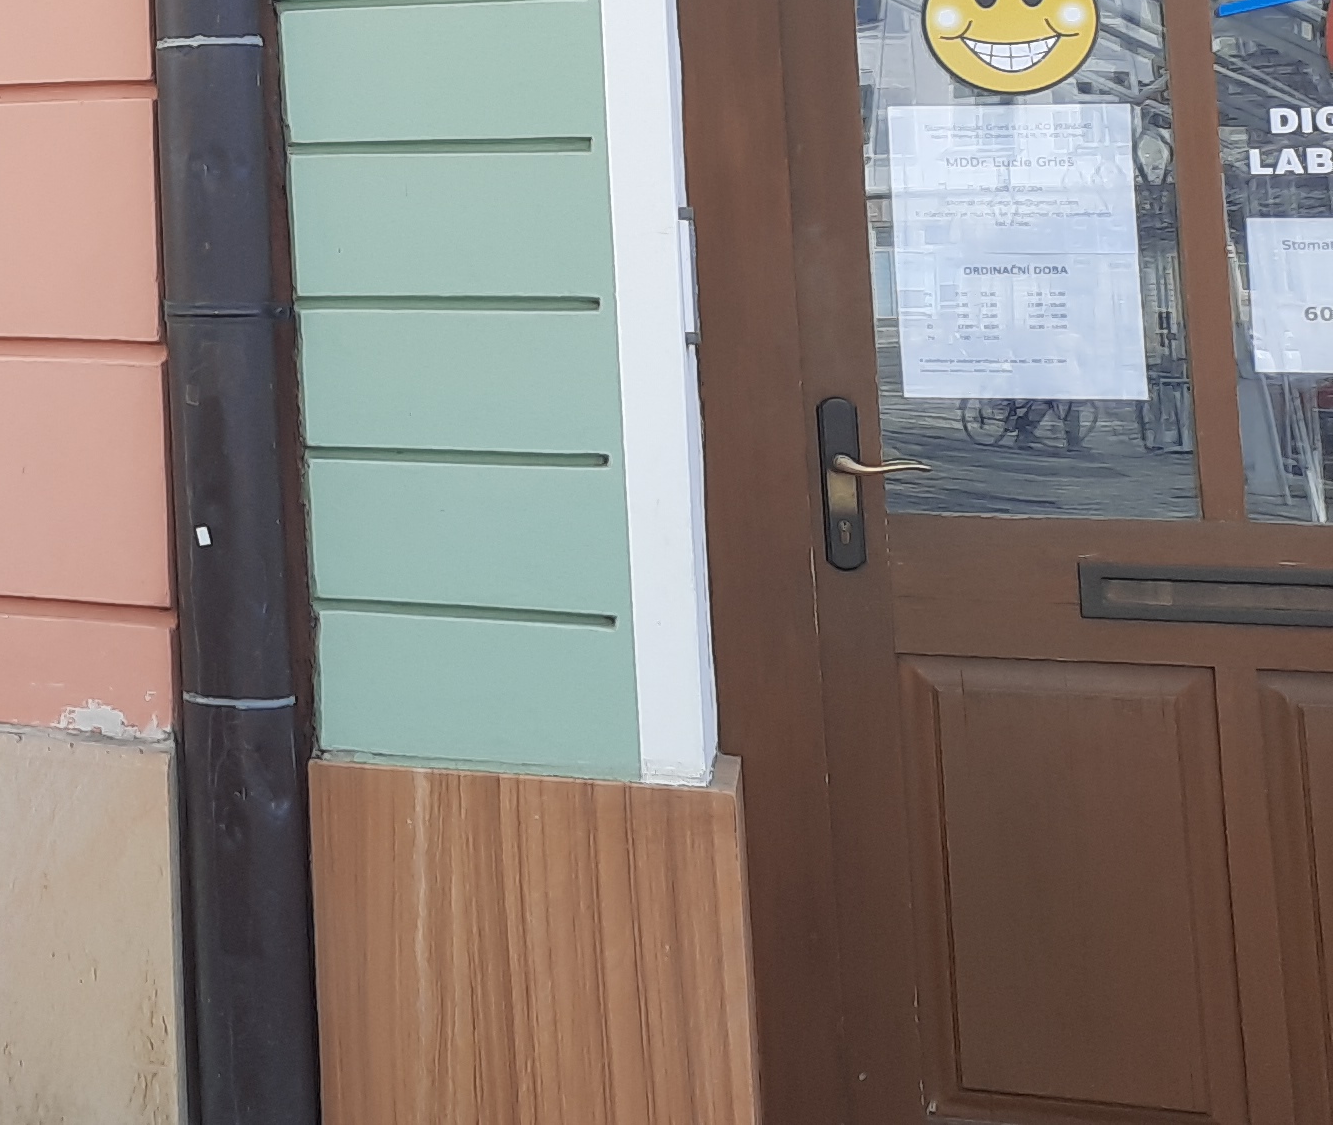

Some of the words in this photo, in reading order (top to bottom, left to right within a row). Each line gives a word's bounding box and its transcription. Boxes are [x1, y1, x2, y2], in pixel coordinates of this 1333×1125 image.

[1248, 147, 1333, 175] LAB
[963, 264, 1030, 276] ORDINAČNÍ
[1033, 265, 1069, 276] DOBA
